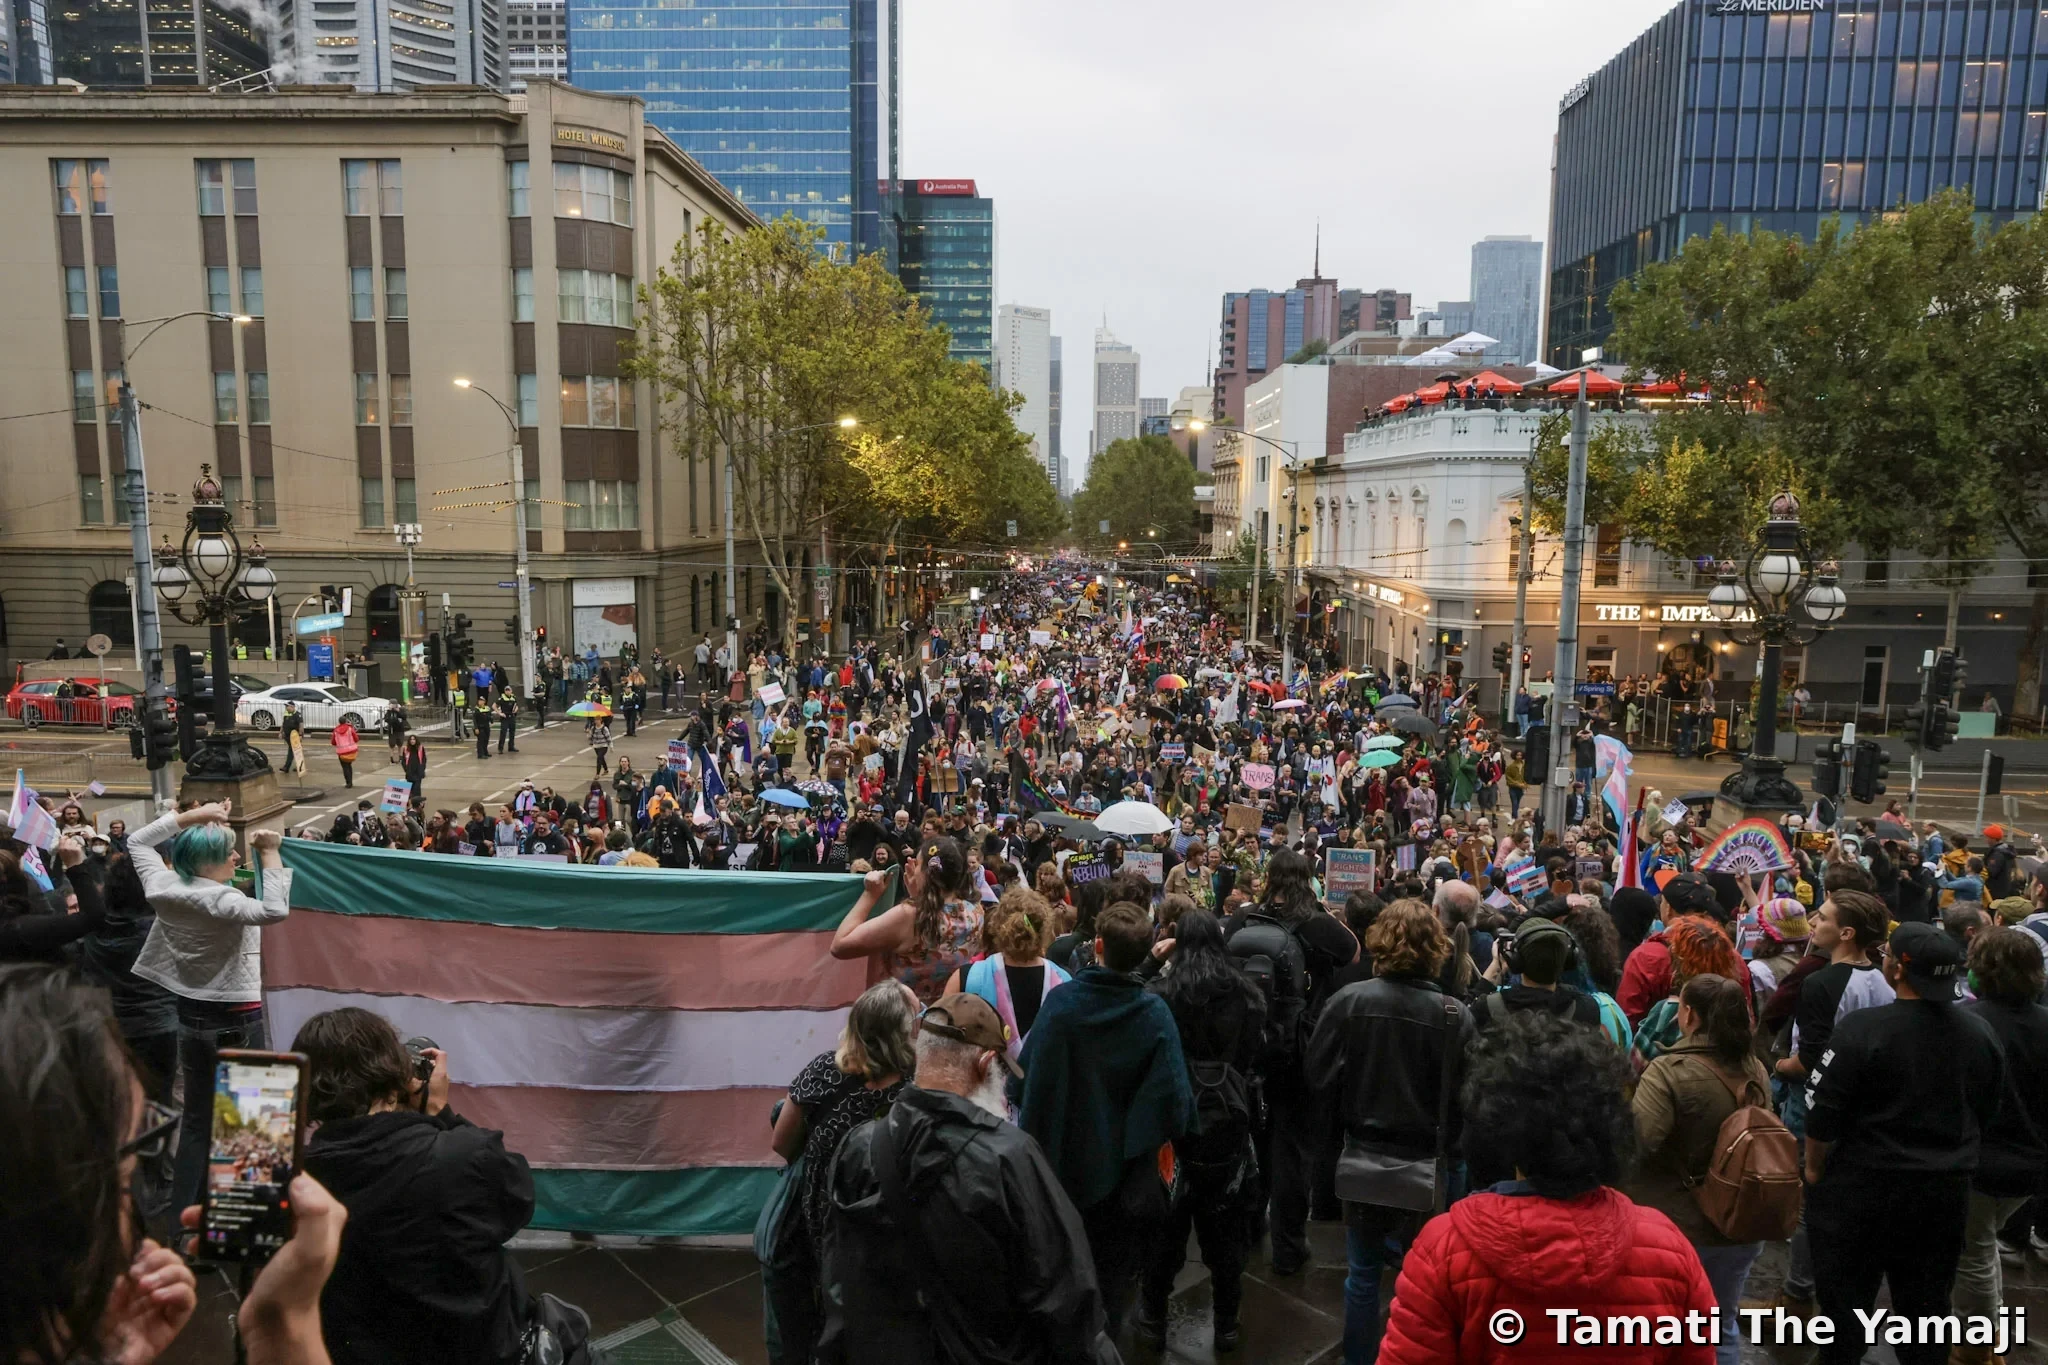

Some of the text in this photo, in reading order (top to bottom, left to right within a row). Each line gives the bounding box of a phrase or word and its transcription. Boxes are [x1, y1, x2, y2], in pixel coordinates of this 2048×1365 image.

[1717, 0, 1739, 11] Le
[558, 130, 626, 152] HOTEL WINDSOR
[599, 584, 630, 592] WINDSOR
[1596, 605, 1641, 621] THE
[1584, 685, 1604, 694] Spring
[1244, 769, 1273, 784] TRANS
[1070, 853, 1094, 862] GENDER
[1127, 853, 1155, 862] TRANS
[1337, 852, 1364, 861] TRANS
[1334, 863, 1366, 871] RIGHTS
[1072, 863, 1111, 883] REBELLION
[1332, 883, 1366, 891] HUMAN
